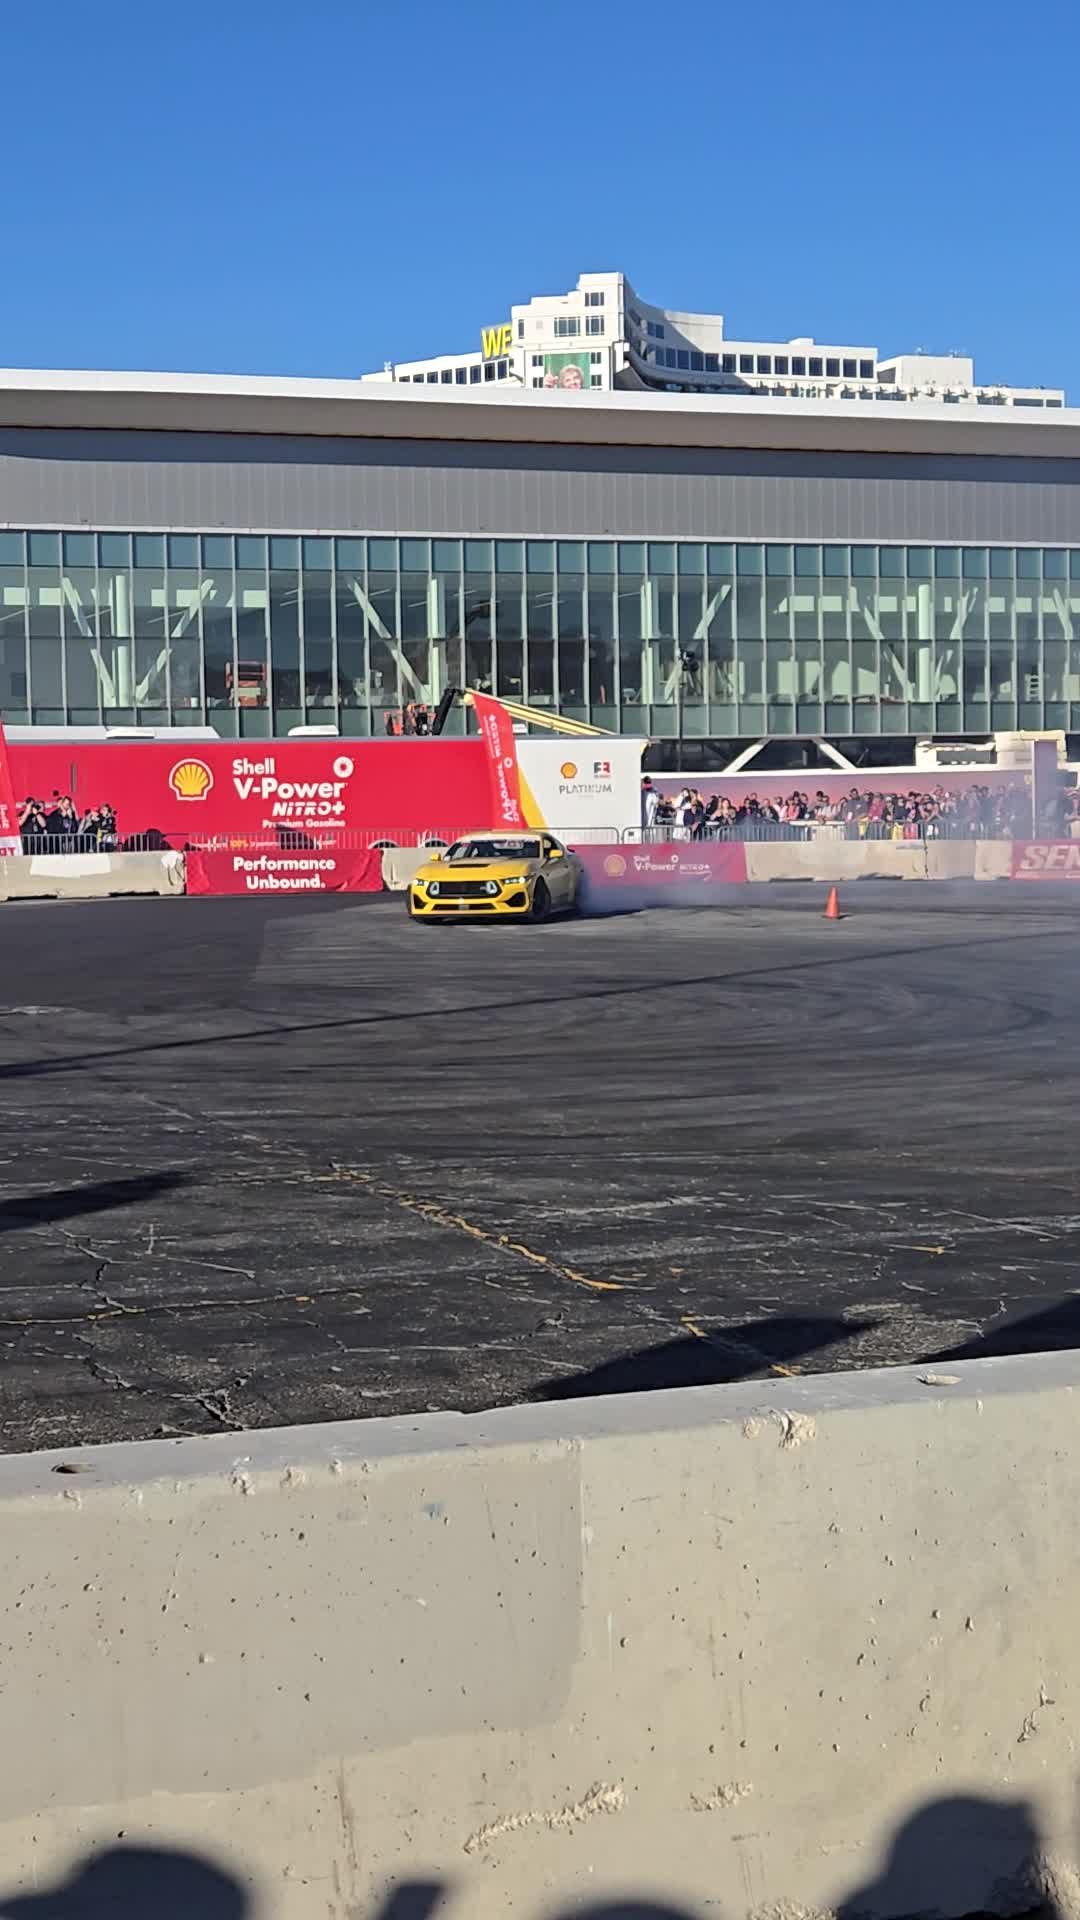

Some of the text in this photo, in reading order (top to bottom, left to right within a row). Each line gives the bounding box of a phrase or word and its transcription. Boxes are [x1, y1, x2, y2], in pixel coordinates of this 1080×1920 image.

[232, 757, 275, 775] Shell
[233, 777, 345, 800] V-Power
[305, 818, 346, 828] Gasoline
[233, 855, 336, 872] Performance
[246, 874, 326, 889] Unbound.
